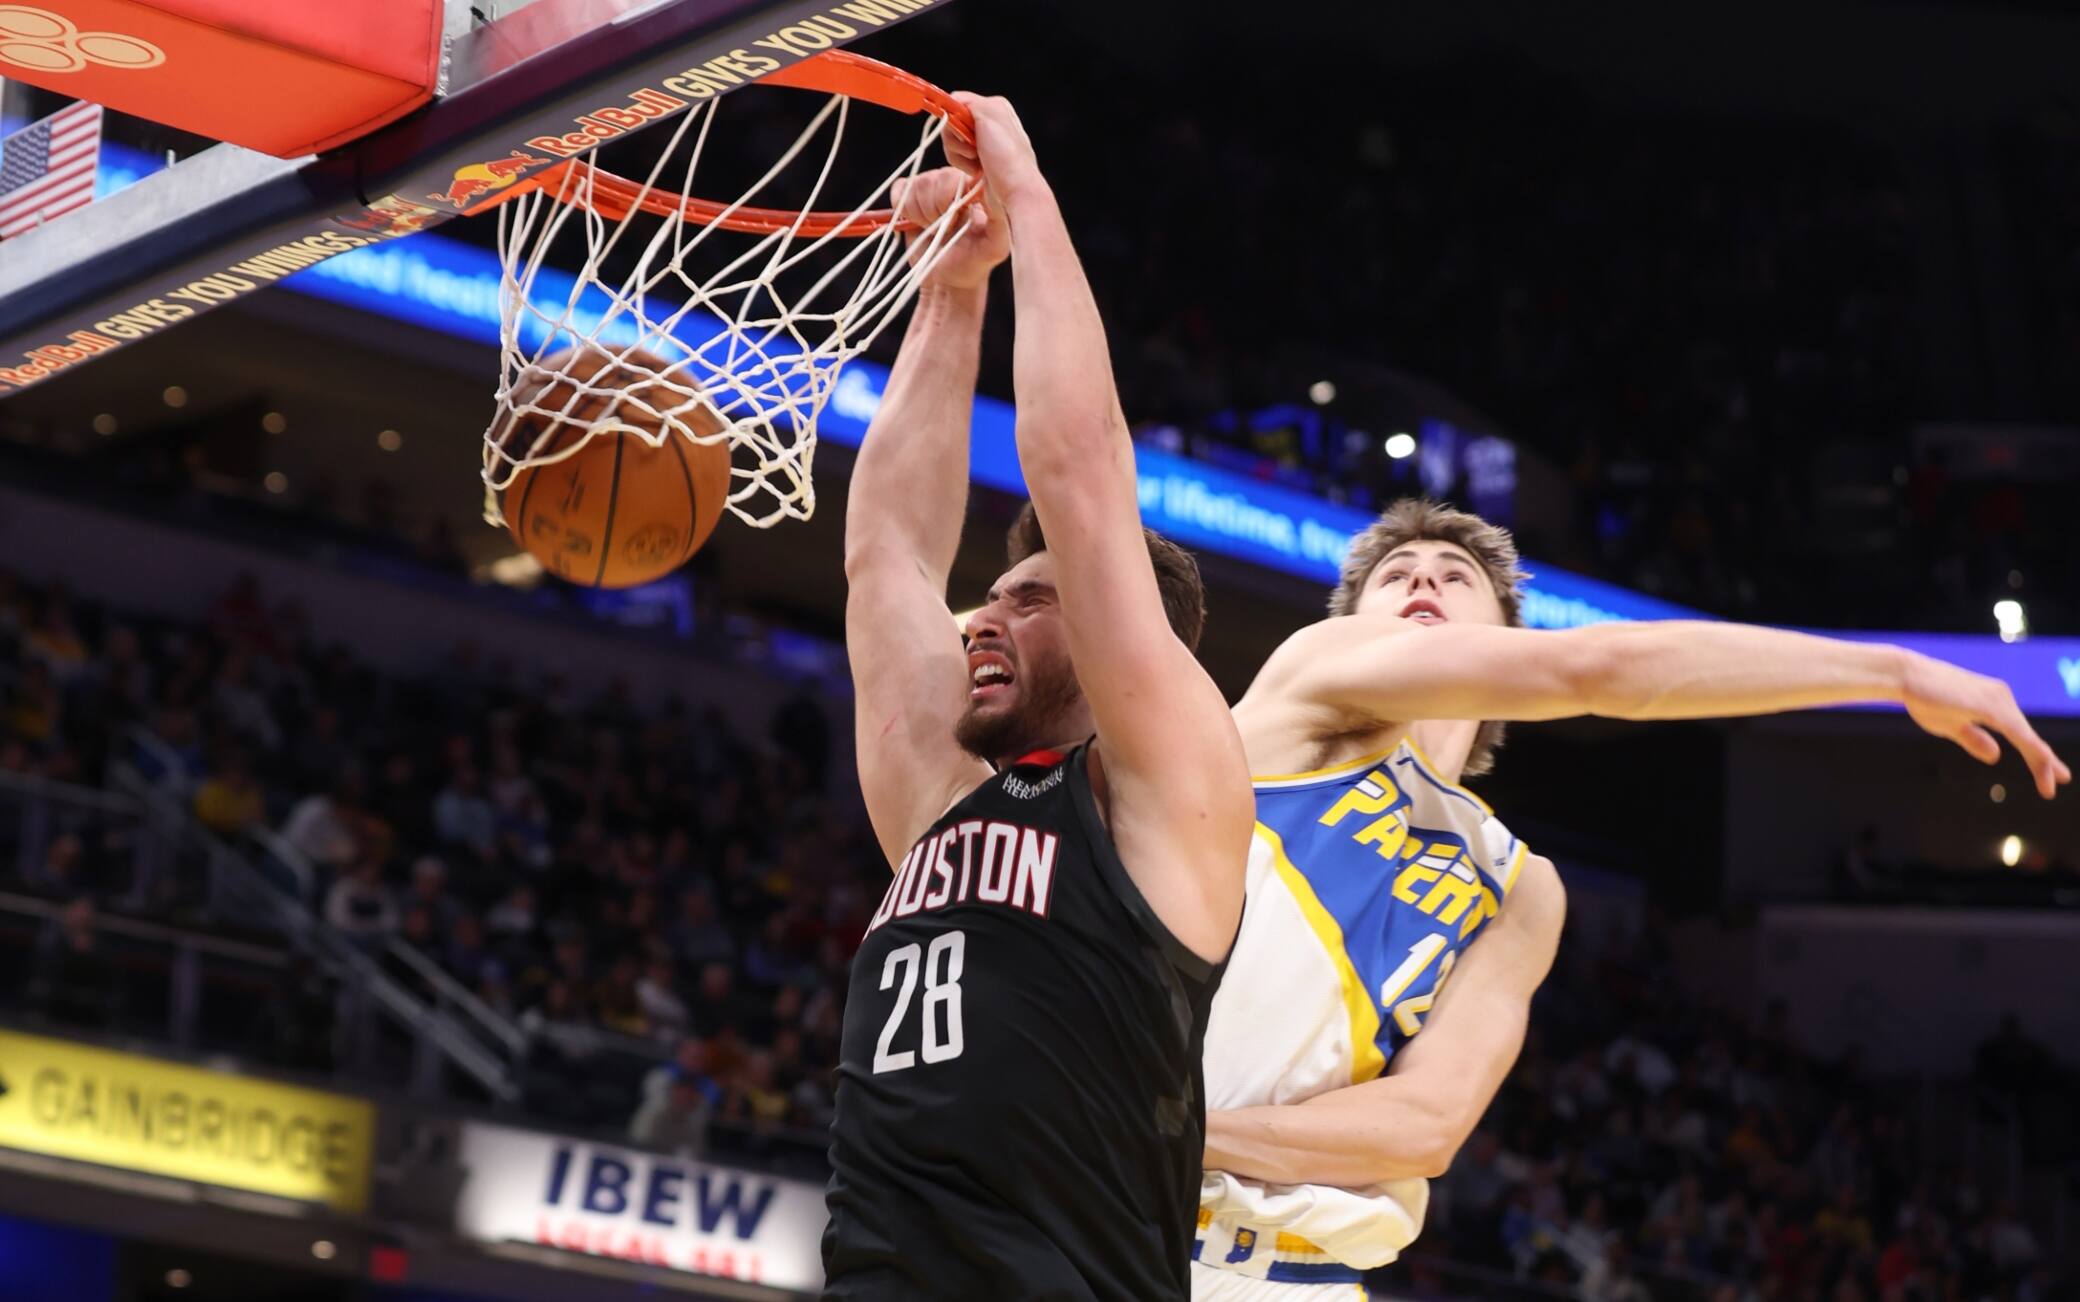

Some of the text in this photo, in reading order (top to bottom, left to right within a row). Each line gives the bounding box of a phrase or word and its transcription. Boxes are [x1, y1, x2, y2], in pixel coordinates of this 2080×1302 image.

[662, 48, 782, 99] GIVES
[752, 14, 858, 57] YOU
[94, 298, 196, 340] GIVES
[166, 277, 257, 308] YOU
[862, 819, 1059, 942] OUSTON
[872, 930, 966, 1074] 28
[30, 1065, 351, 1186] GAINBRIDGE
[543, 1147, 779, 1241] IBEW
